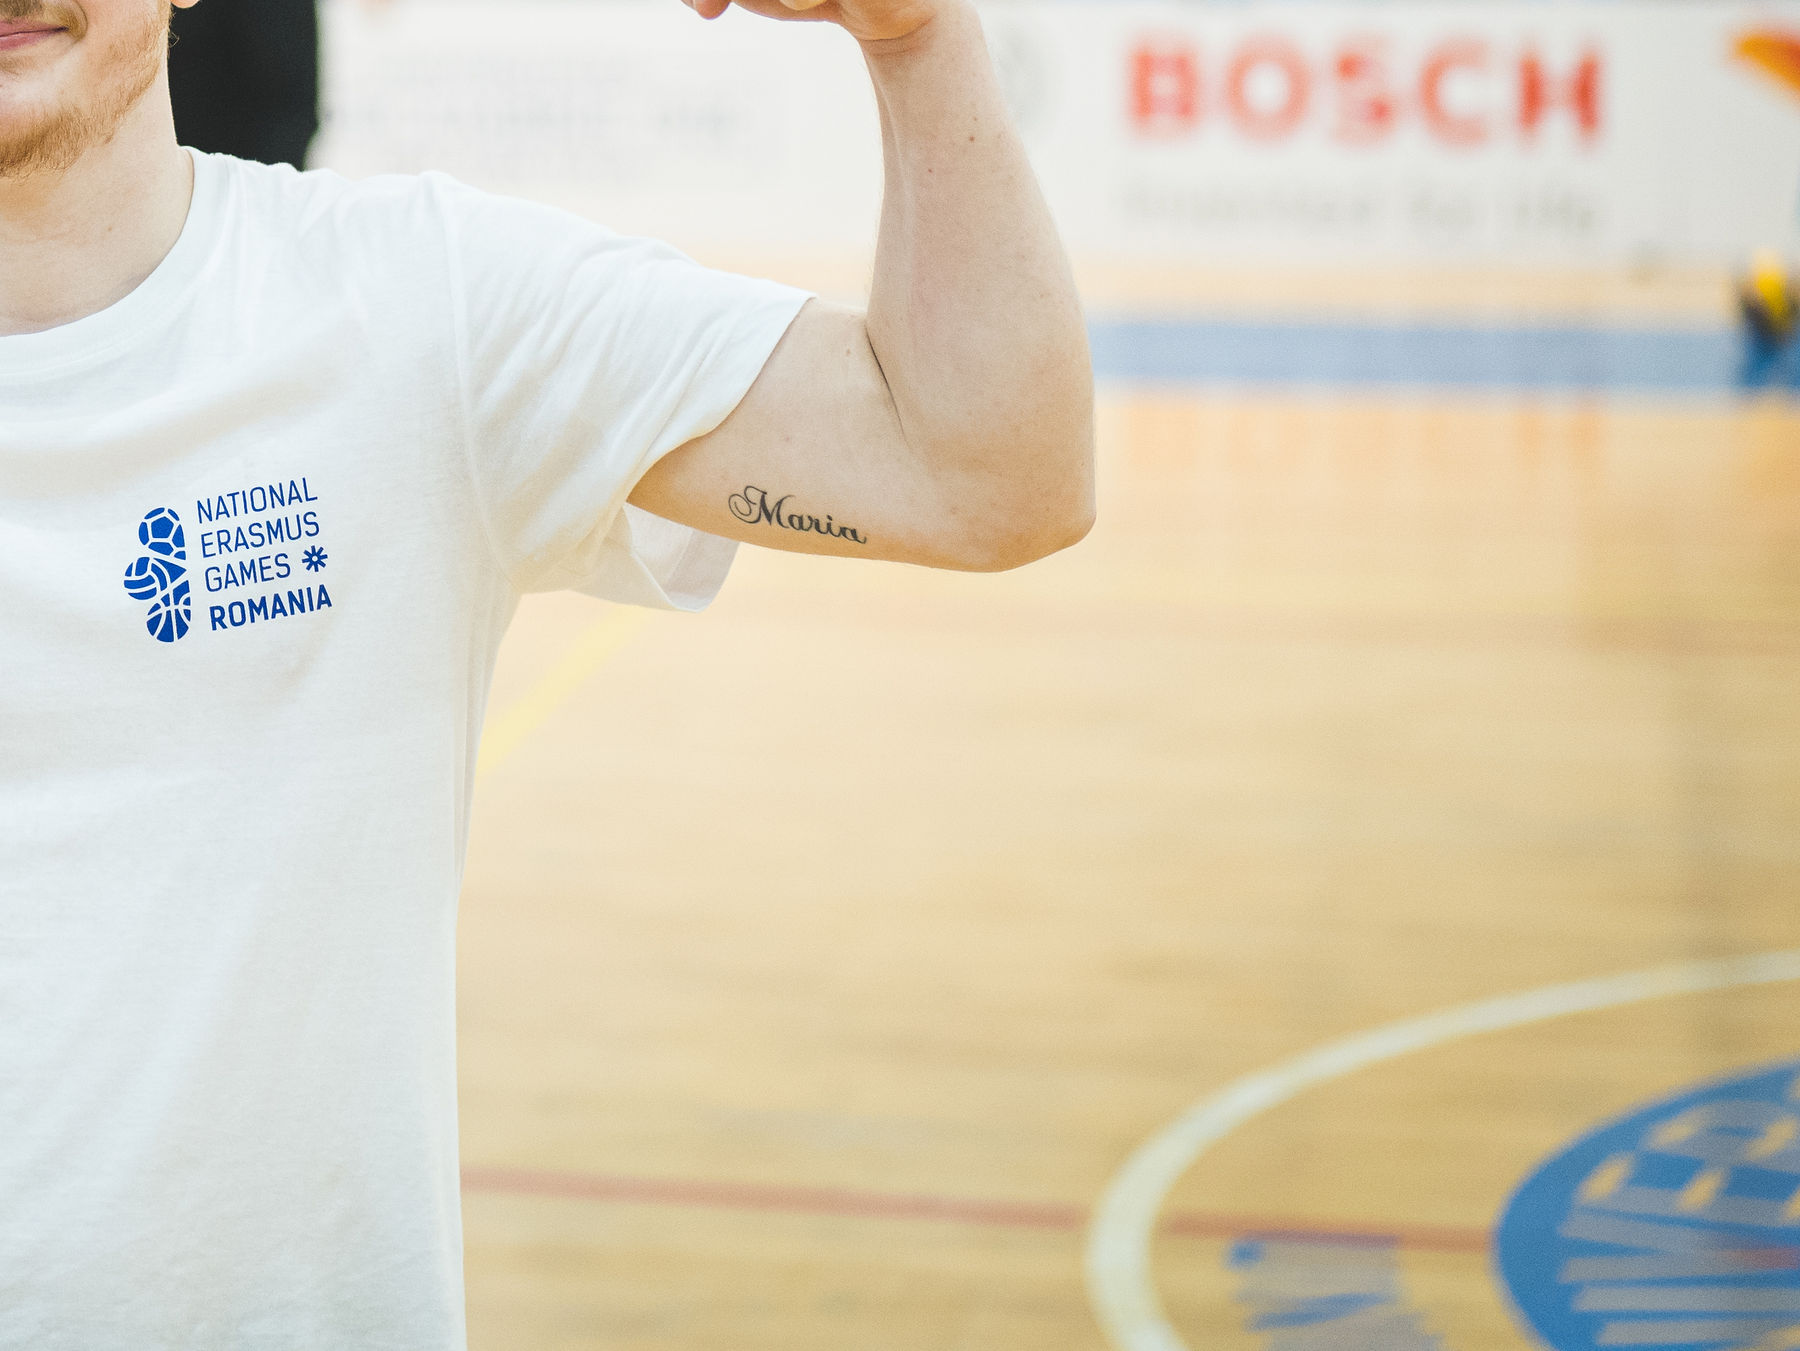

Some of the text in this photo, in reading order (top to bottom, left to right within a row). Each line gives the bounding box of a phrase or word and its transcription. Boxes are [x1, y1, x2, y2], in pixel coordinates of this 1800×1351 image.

[1128, 36, 1604, 144] BOSCH
[197, 477, 318, 524] NATIONAL
[728, 485, 867, 545] Maria
[200, 511, 320, 559] ERASMUS
[204, 553, 291, 592] GAMES
[209, 584, 333, 631] ROMANIA
